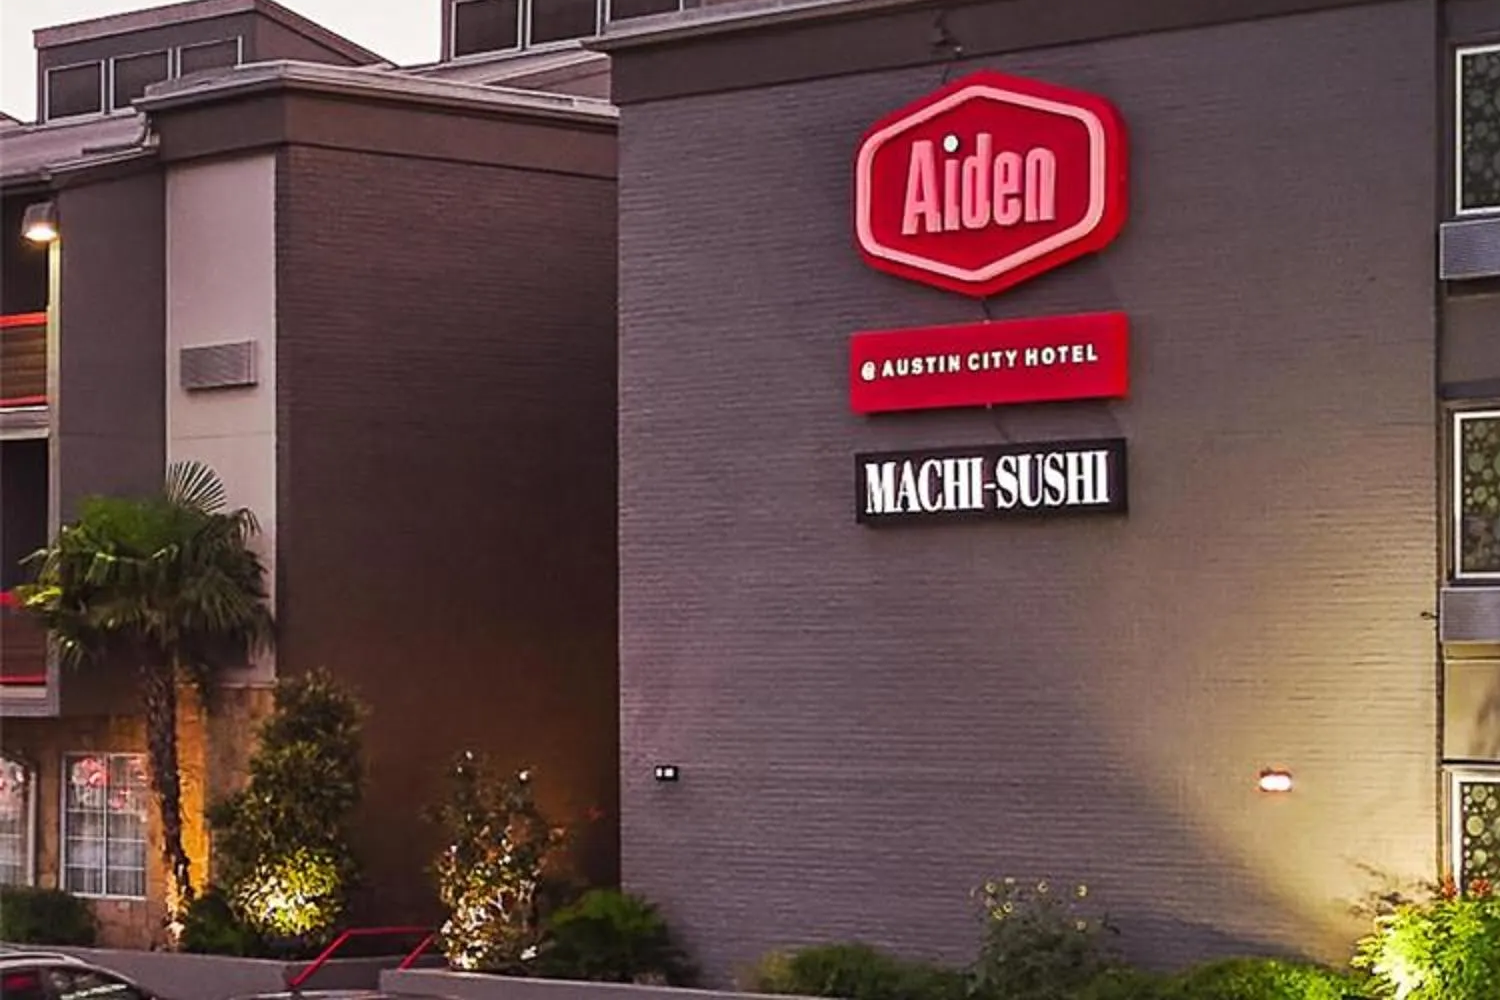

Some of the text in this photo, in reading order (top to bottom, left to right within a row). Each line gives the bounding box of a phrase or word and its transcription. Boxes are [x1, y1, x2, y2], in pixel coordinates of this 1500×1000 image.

[902, 133, 1056, 235] Aiden
[882, 357, 961, 378] AUSTIN
[967, 349, 1018, 371] CITY
[1024, 344, 1099, 367] HOTEL
[864, 449, 1110, 515] MACHI-SUSHI
